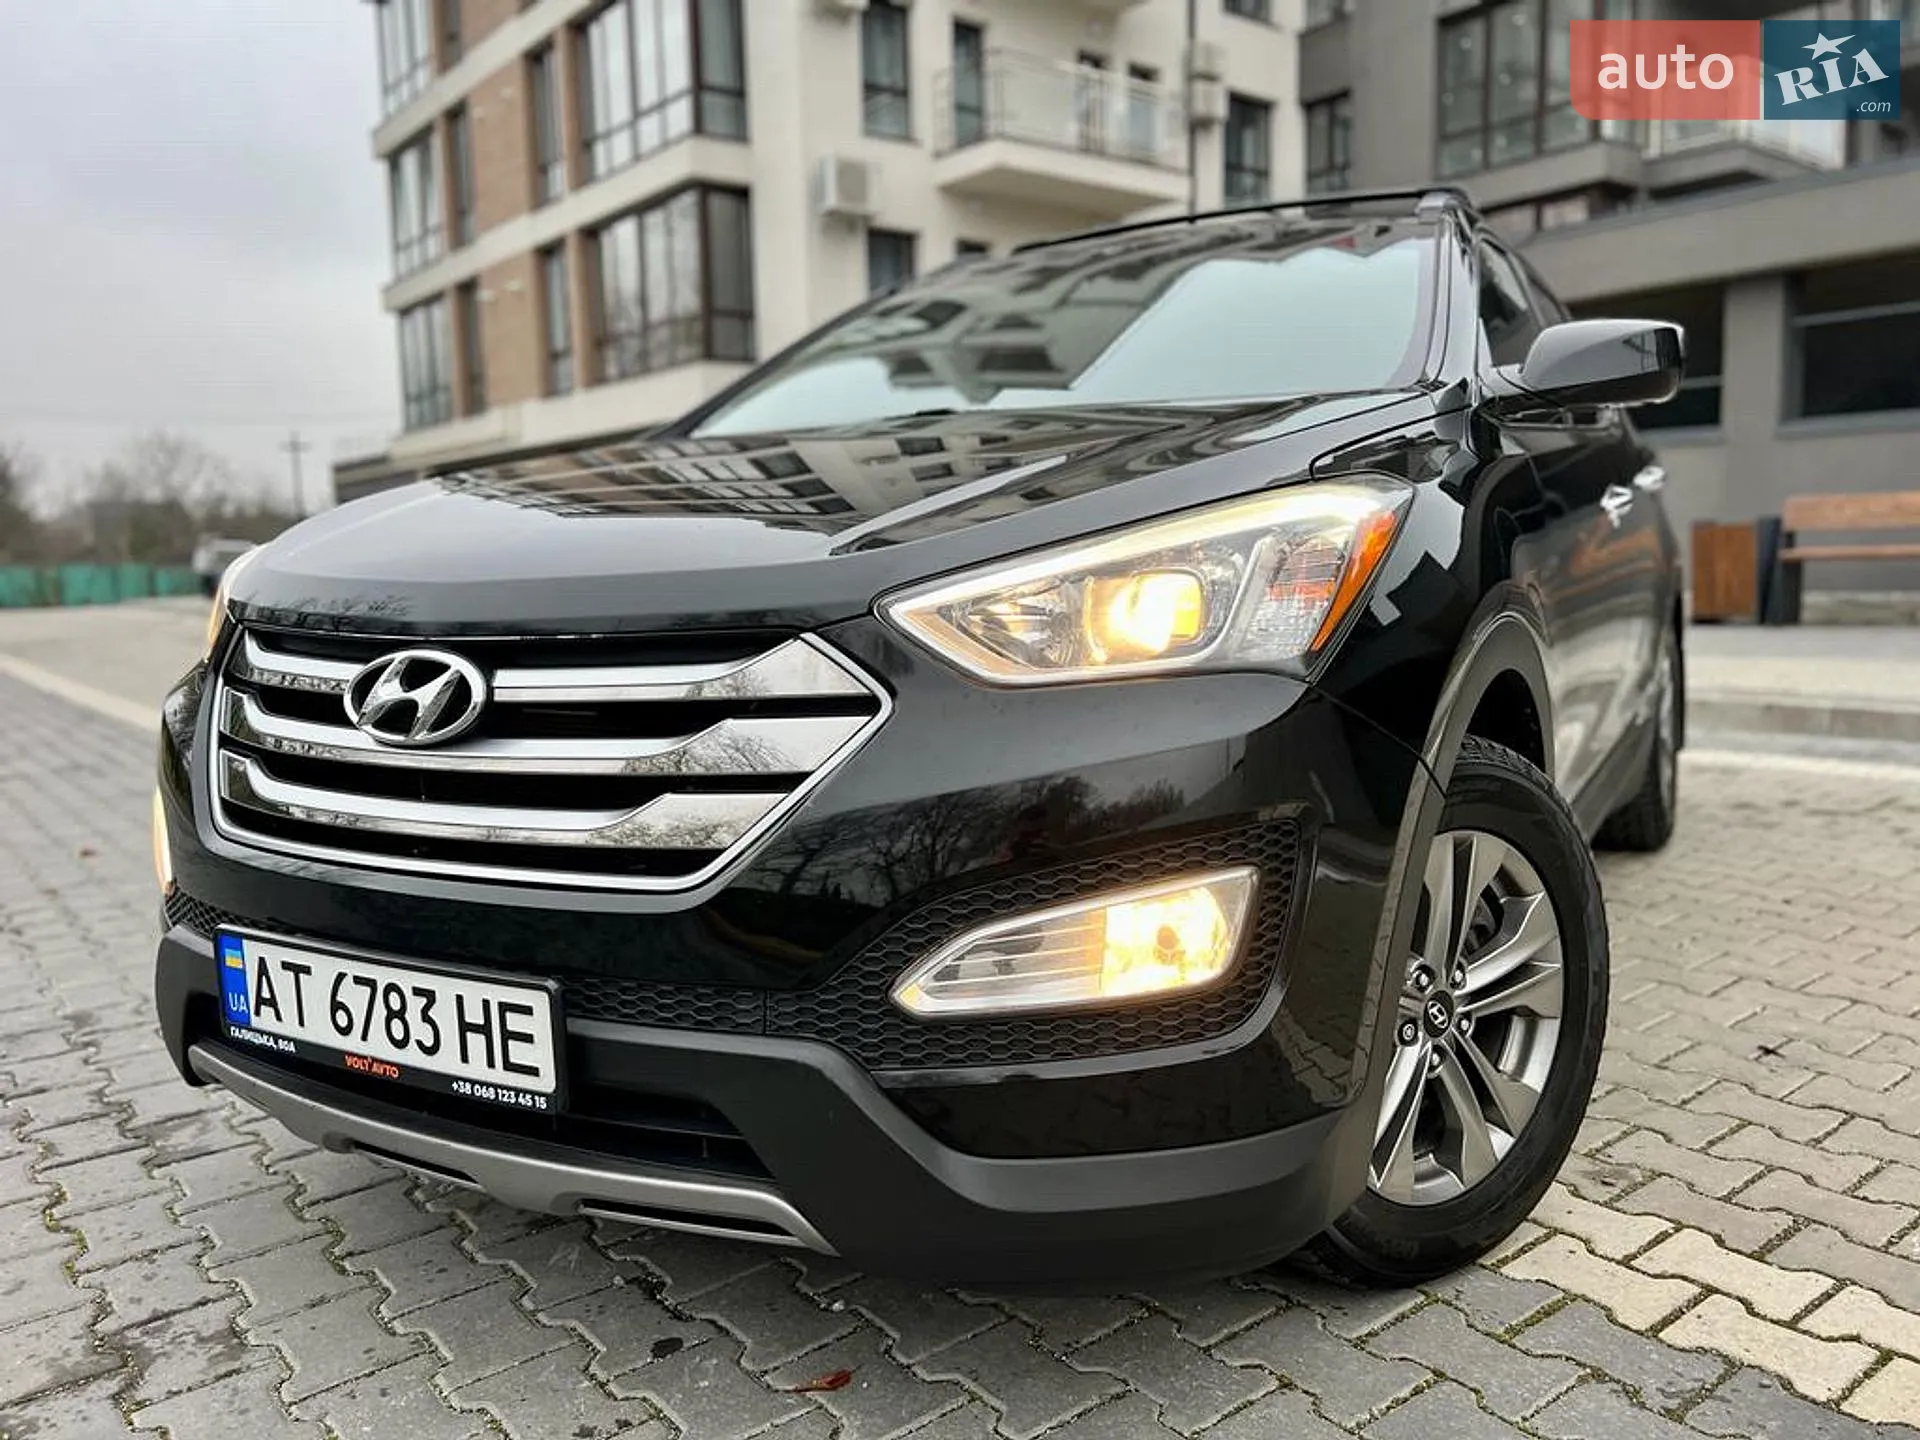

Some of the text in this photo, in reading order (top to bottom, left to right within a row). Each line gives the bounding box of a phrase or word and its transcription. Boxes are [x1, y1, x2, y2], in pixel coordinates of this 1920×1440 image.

[229, 992, 248, 1013] UA
[253, 956, 540, 1077] AT 6783 HE
[452, 1080, 547, 1109] +38 068 123 45 15
